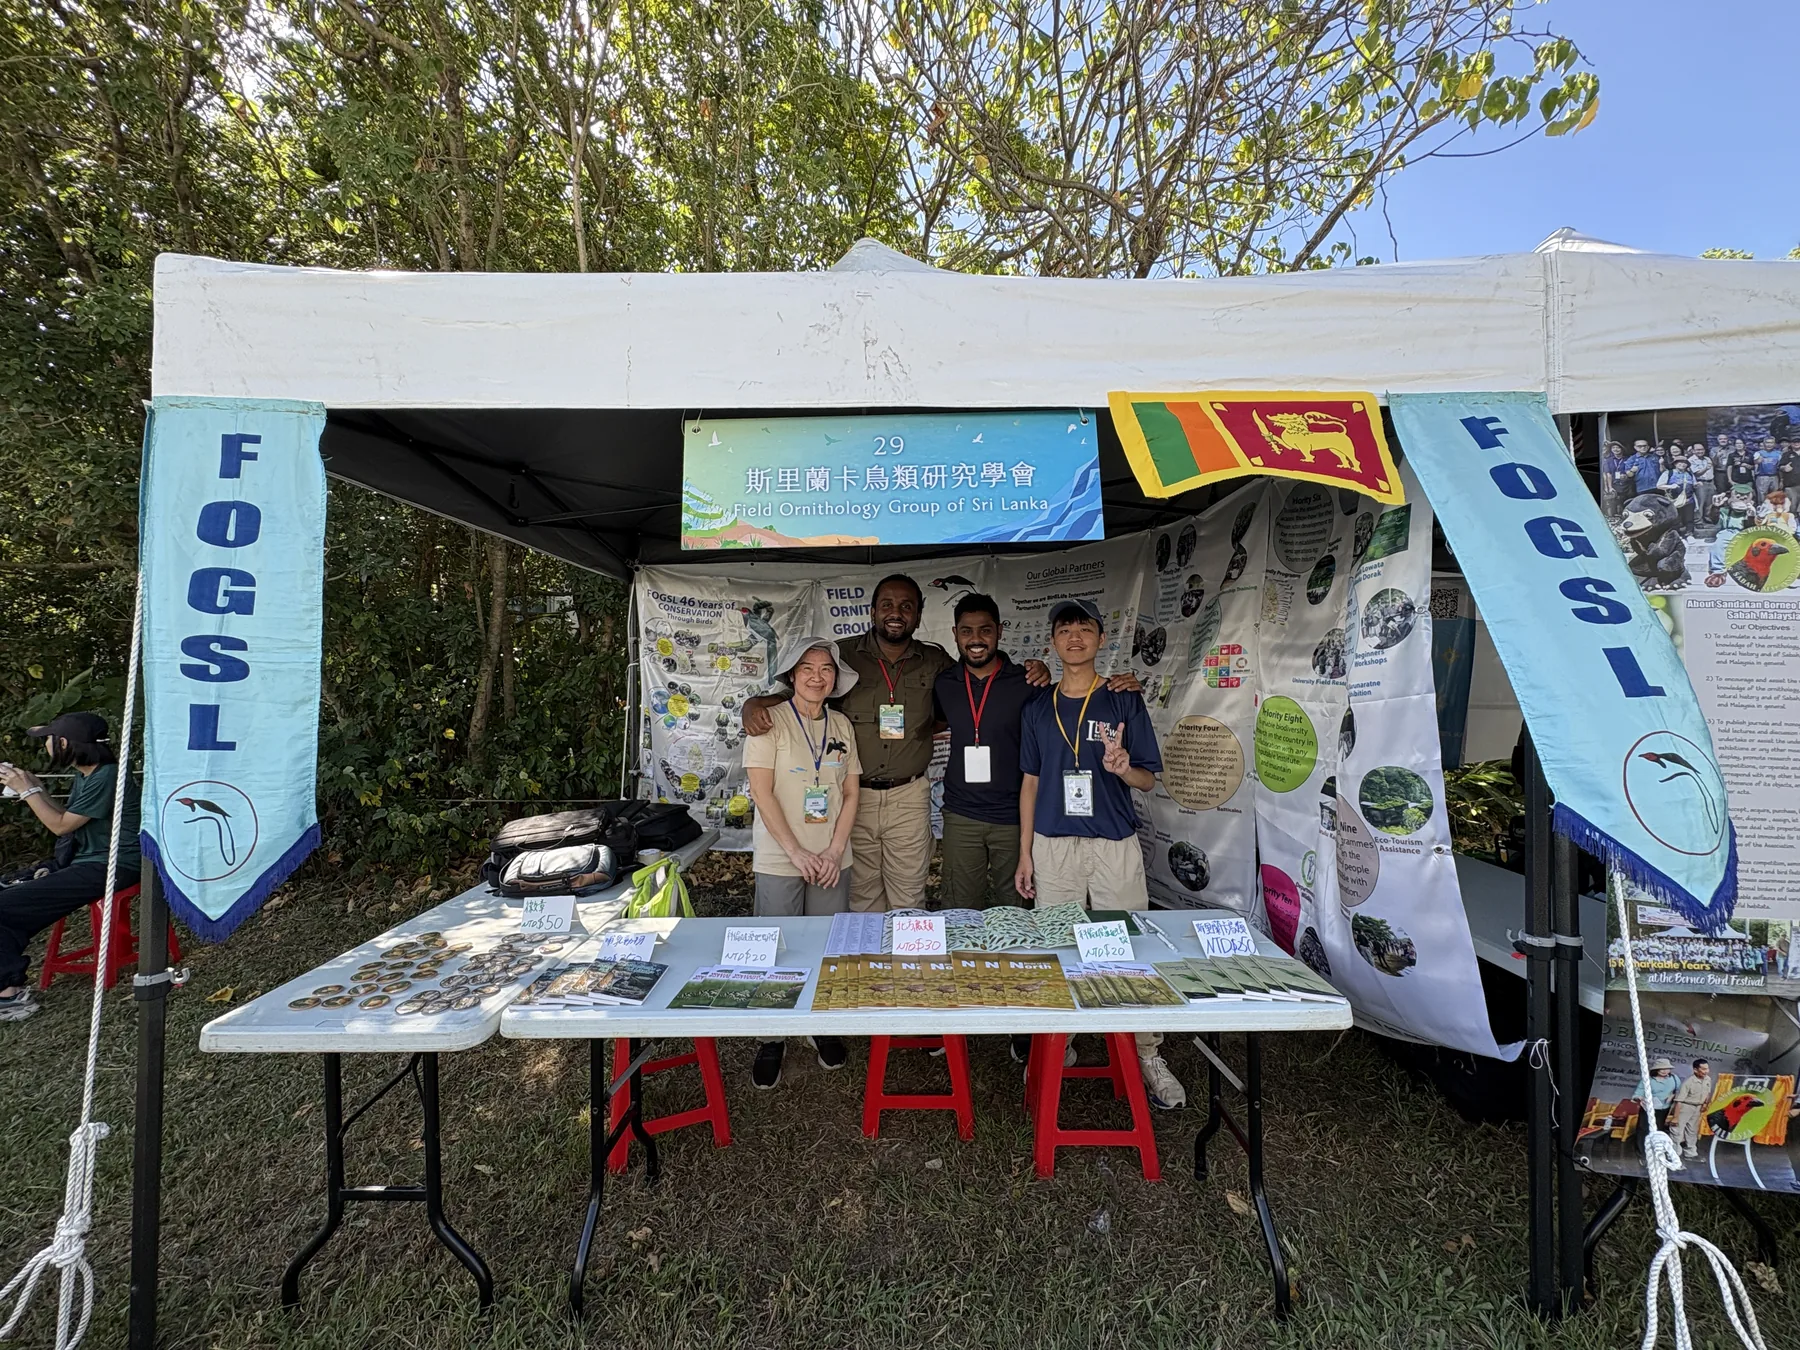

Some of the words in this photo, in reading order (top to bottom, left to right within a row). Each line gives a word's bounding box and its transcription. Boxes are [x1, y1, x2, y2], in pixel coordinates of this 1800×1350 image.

[874, 436, 904, 456] 29
[745, 460, 1037, 494] 斯里蘭卡鳥類研究學會
[734, 500, 772, 518] Field
[780, 499, 881, 519] Ornithology
[889, 498, 940, 517] Group
[948, 497, 965, 512] of
[972, 496, 995, 512] Sri
[1001, 495, 1048, 512] Lanka
[1459, 415, 1667, 698] FOGSL
[1026, 571, 1041, 580] Our
[1042, 564, 1067, 578] Global
[1069, 560, 1105, 573] Partners
[1363, 569, 1382, 580] Dorak
[1733, 571, 1757, 590] SABAH
[180, 433, 262, 751] FOGSL
[826, 587, 864, 600] FIELD
[647, 589, 678, 604] FOGSL
[680, 596, 696, 607] 46
[697, 599, 723, 609] Years
[724, 602, 735, 610] of
[1687, 599, 1714, 608] About
[1716, 599, 1762, 609] Sandakan
[1763, 601, 1797, 610] Borneo
[658, 602, 723, 617] CONSERVATION
[830, 604, 871, 617] ORNIT
[1727, 610, 1759, 621] Sabah,
[667, 613, 694, 624] Through
[833, 621, 872, 635] GROU
[1748, 623, 1790, 631] Objectives
[1355, 649, 1385, 660] Beginners
[1354, 657, 1387, 667] Workshops
[1284, 713, 1303, 724] Eight
[1178, 724, 1202, 732] Priority
[1194, 754, 1215, 762] strategic
[1295, 748, 1308, 757] any
[1196, 784, 1214, 792] biology
[1340, 821, 1357, 834] Nine
[1340, 837, 1374, 848] grammes
[1374, 836, 1423, 846] Eco-Tourism
[1349, 851, 1361, 860] the
[1380, 845, 1421, 855] Assistance
[1344, 862, 1370, 874] people
[1351, 877, 1368, 887] with
[1264, 886, 1280, 899] ority
[1281, 892, 1293, 905] Ten
[896, 937, 942, 952] NTD$30
[1085, 943, 1126, 958] NTD$20
[1009, 961, 1052, 969] North
[1608, 958, 1616, 968] 15
[1618, 959, 1680, 970] Rmarkable
[1682, 959, 1711, 971] Years
[1648, 973, 1659, 983] at
[1659, 972, 1675, 983] the
[1675, 973, 1705, 985] Borneo
[1707, 974, 1728, 986] Bird
[1730, 974, 1765, 987] Festival
[1616, 1026, 1658, 1041] BID
[1662, 1033, 1733, 1054] FESTIVAL
